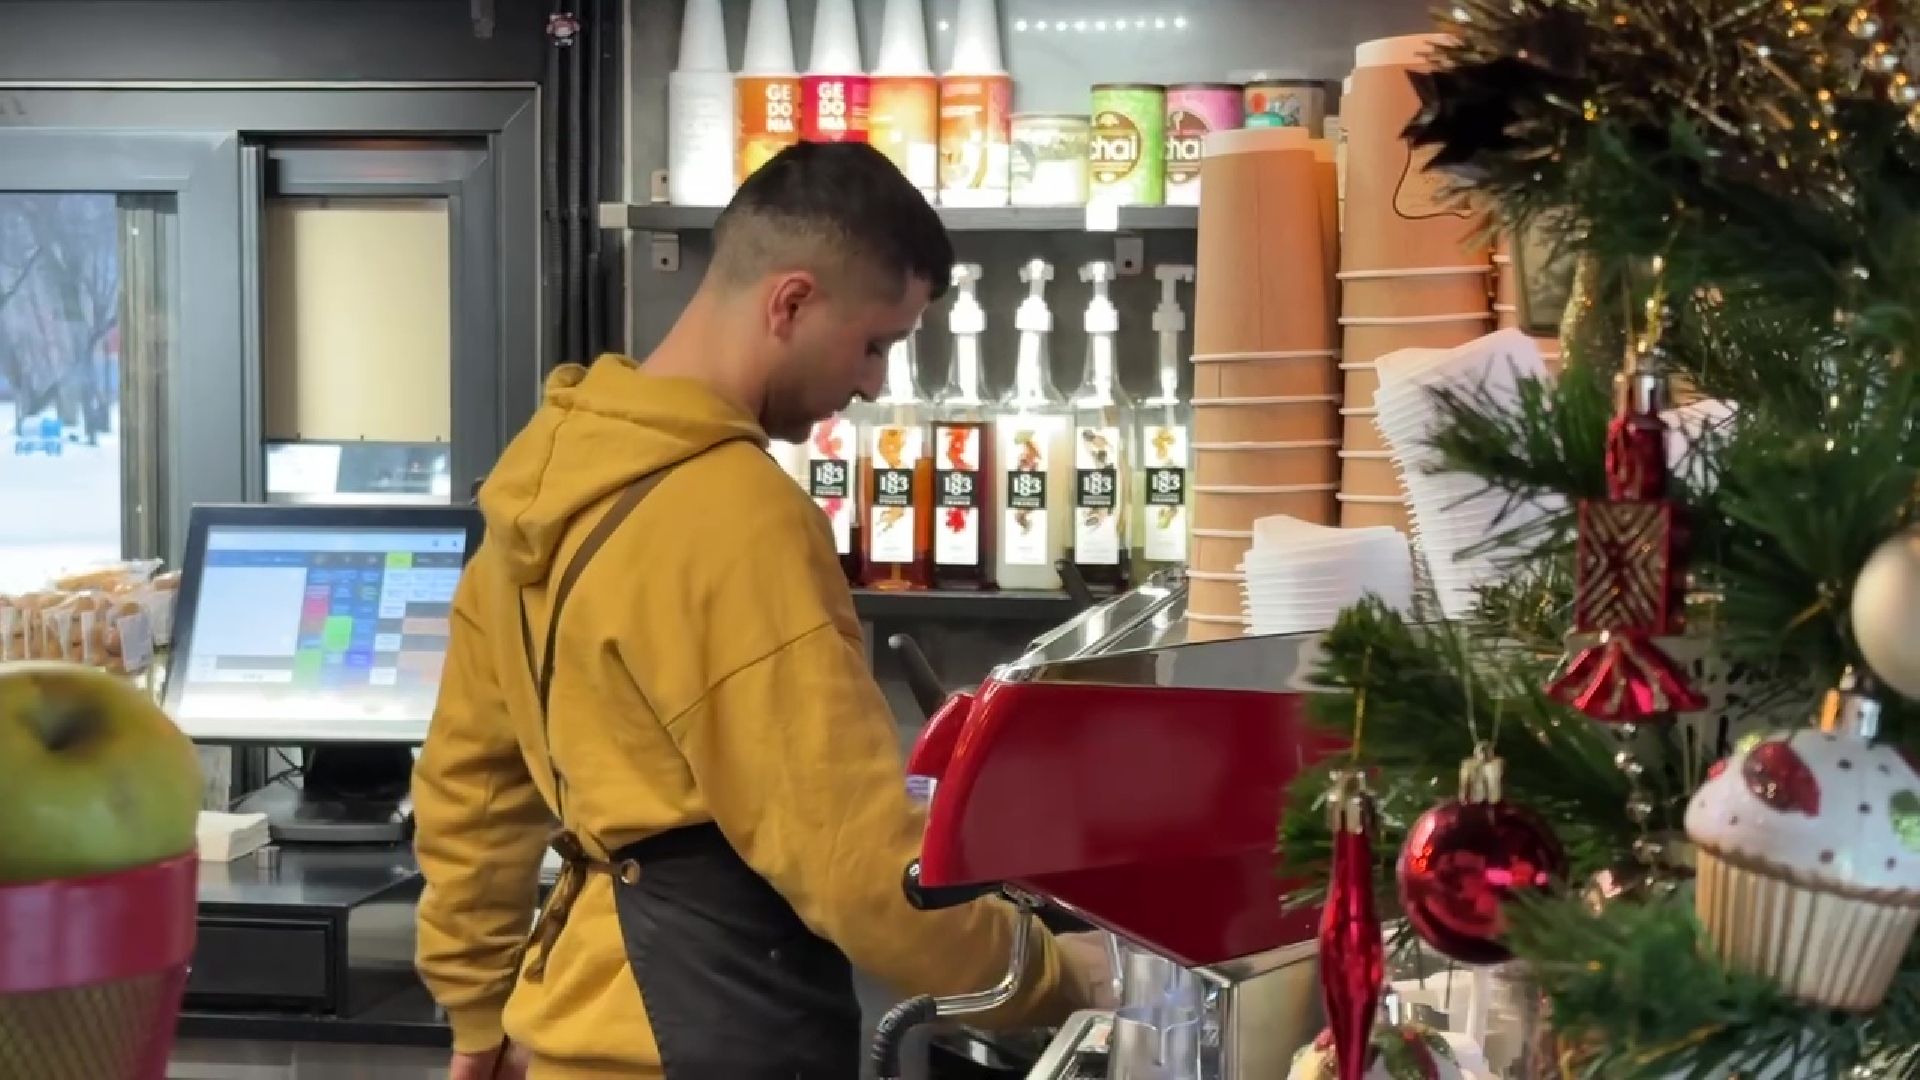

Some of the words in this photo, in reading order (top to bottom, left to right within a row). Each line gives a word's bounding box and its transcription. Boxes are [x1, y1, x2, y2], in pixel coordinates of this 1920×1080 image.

[766, 84, 793, 100] GE
[817, 82, 845, 99] GE
[767, 101, 793, 116] DO
[818, 101, 846, 116] DO
